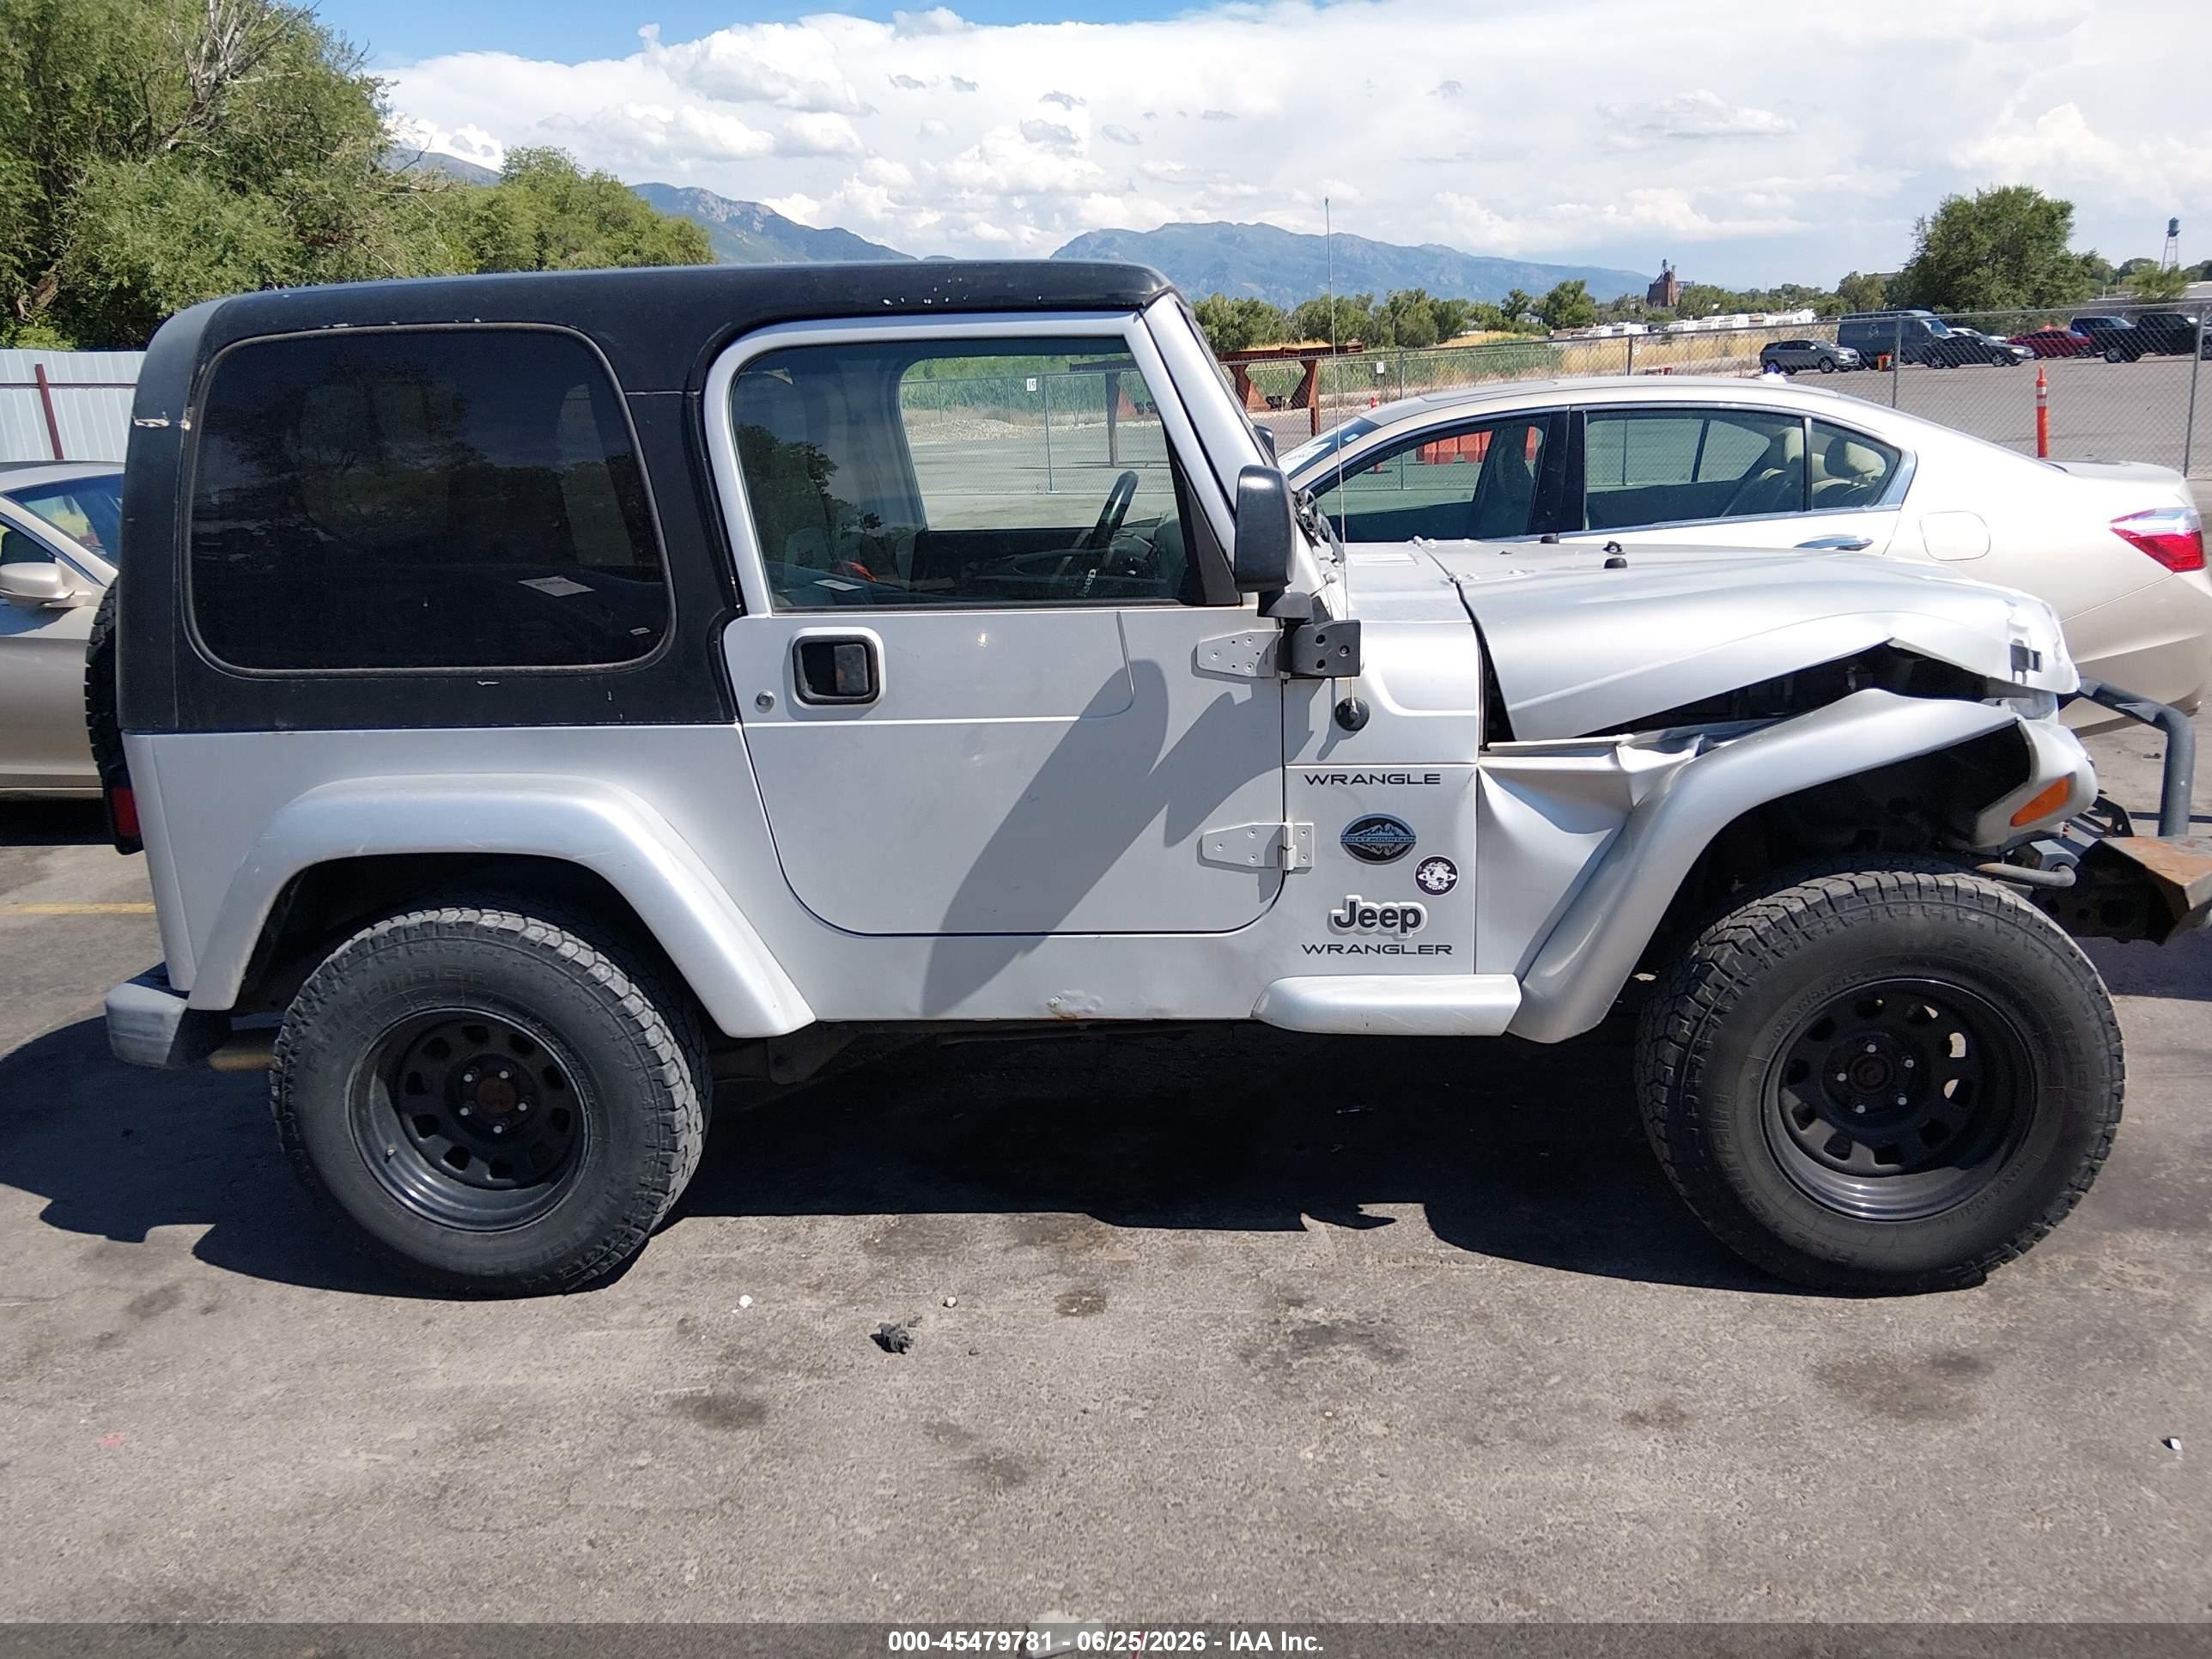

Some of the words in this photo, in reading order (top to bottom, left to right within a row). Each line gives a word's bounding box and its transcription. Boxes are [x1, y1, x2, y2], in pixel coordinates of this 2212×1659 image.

[1304, 774, 1441, 785] WRANGLE
[1334, 902, 1421, 933] Jeep
[1301, 945, 1453, 955] WRANGLER
